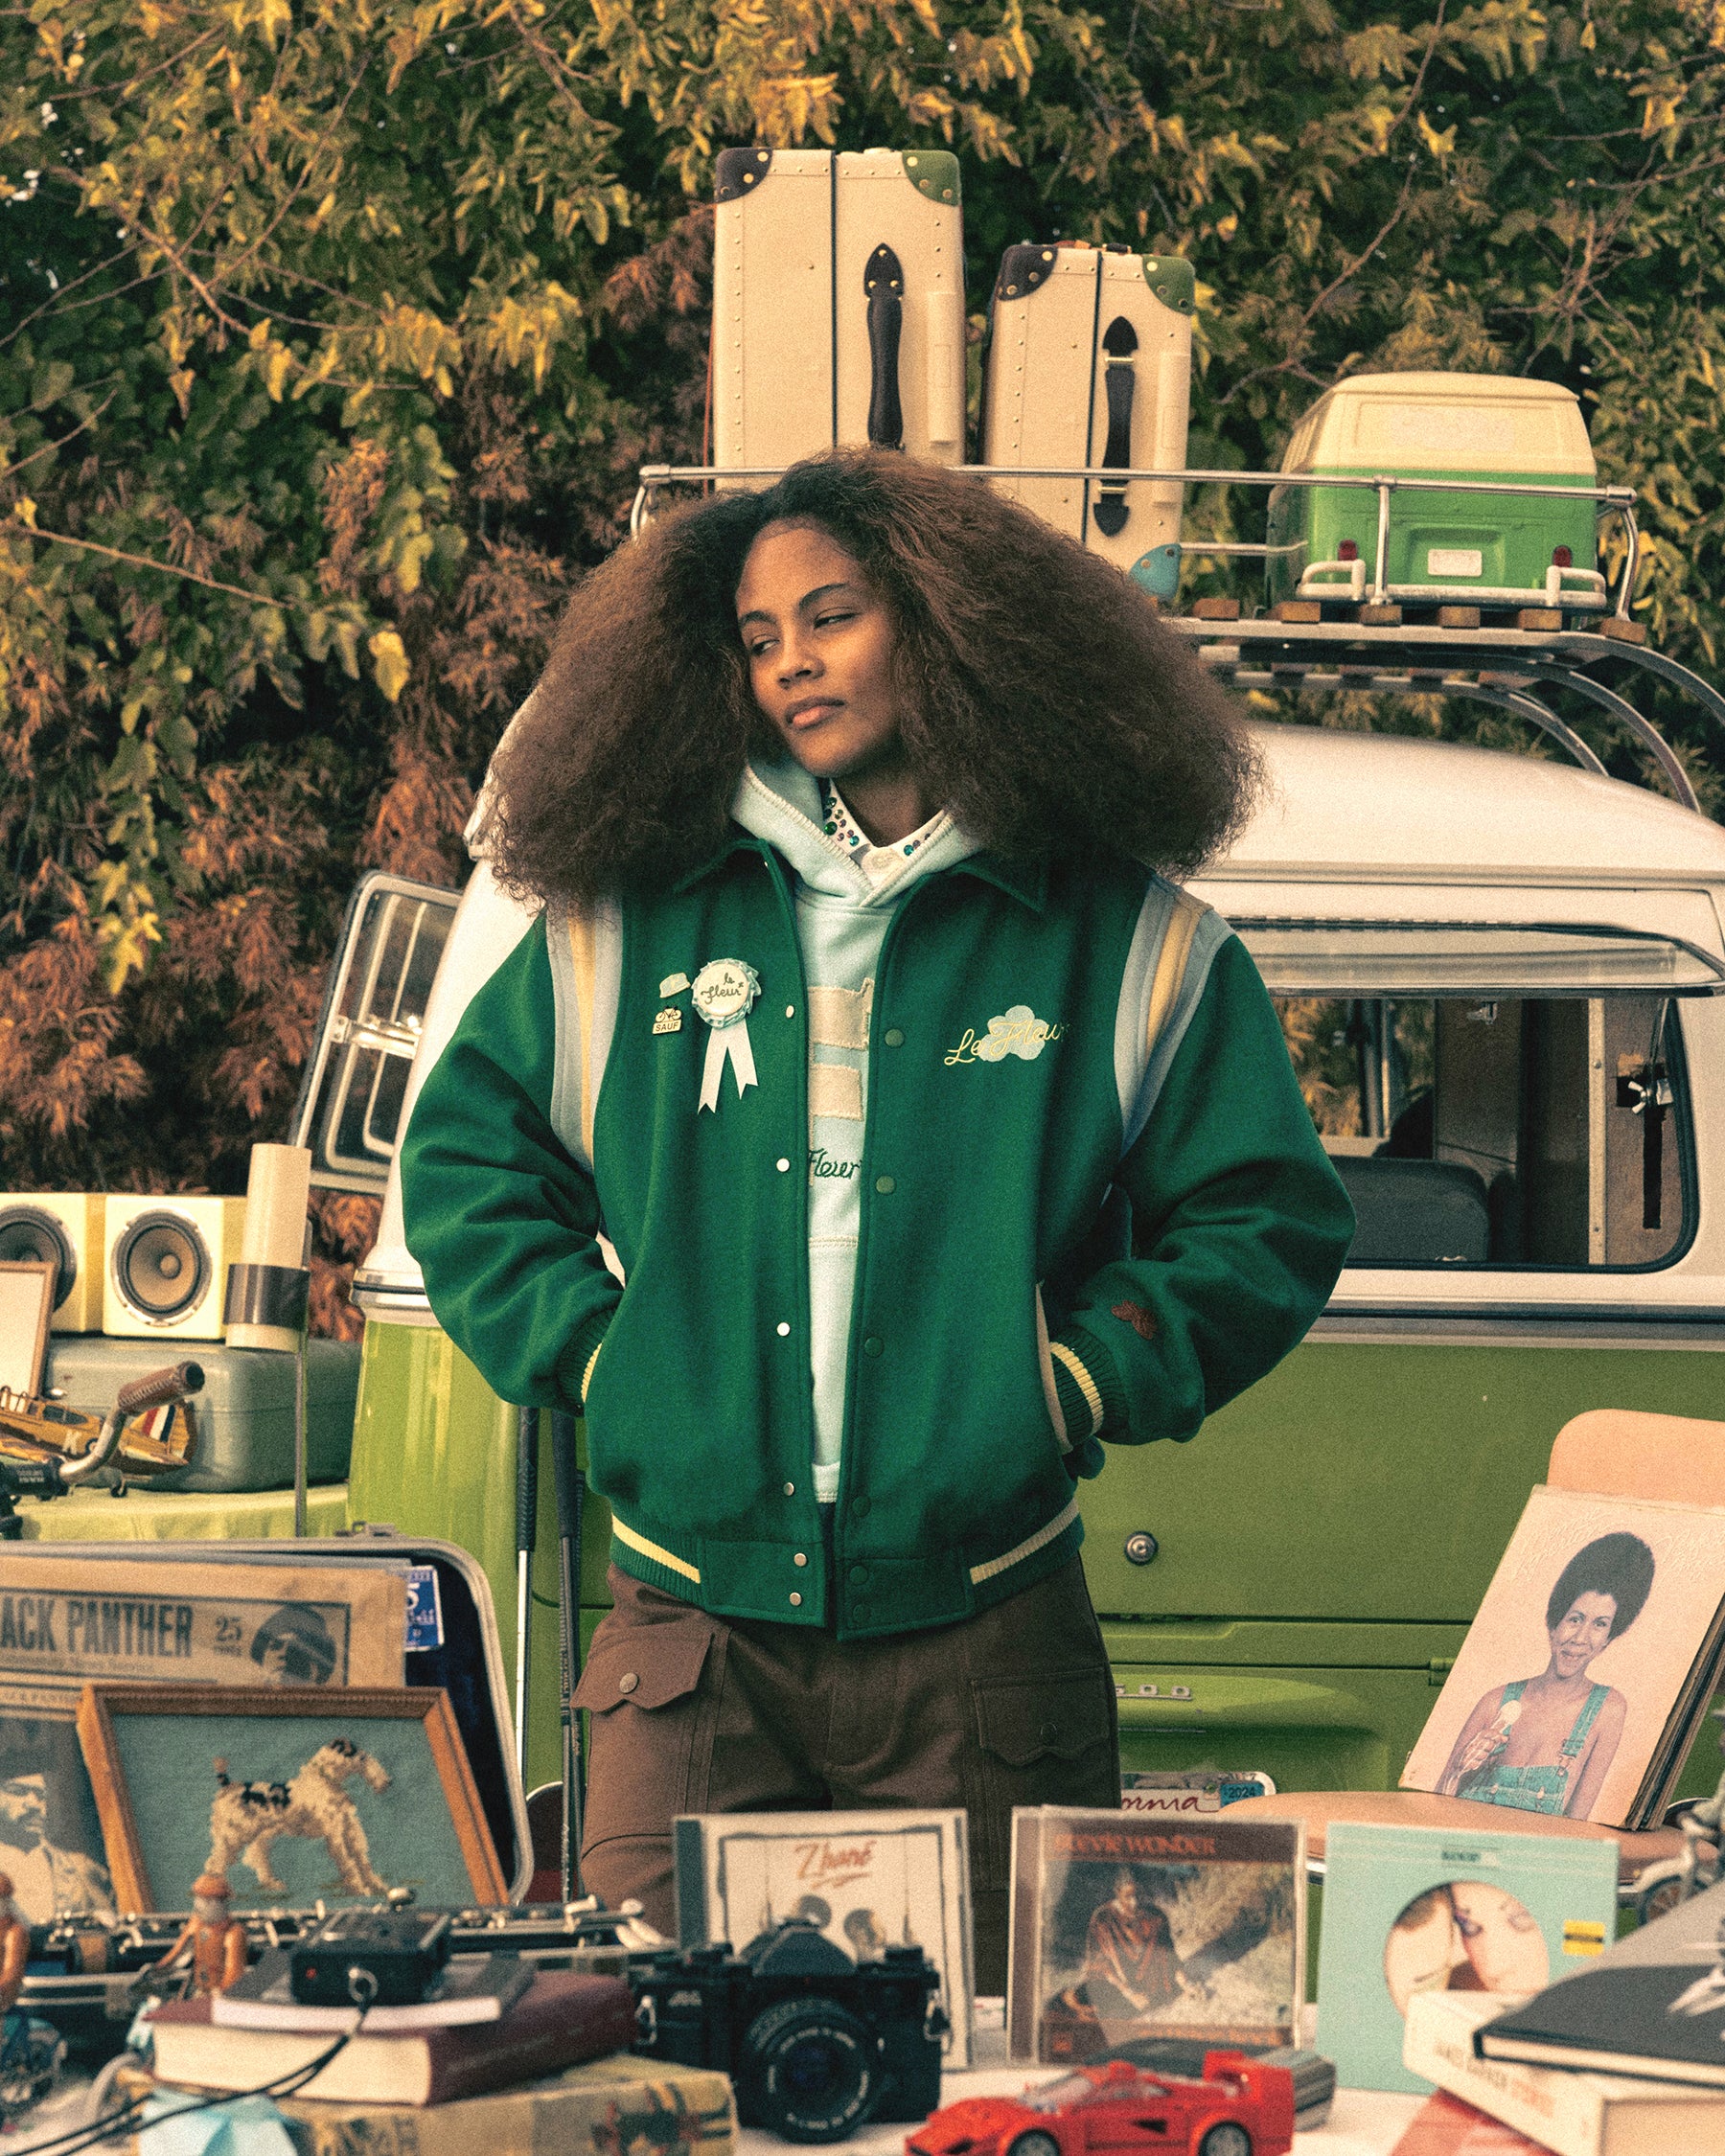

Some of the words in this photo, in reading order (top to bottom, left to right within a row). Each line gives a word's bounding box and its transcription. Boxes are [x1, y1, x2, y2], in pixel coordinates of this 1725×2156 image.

[655, 1021, 679, 1033] SAUF
[943, 1028, 986, 1066] Le
[67, 1599, 192, 1658] PANTHER
[215, 1616, 243, 1641] 25
[1230, 1786, 1256, 1799] 2024
[1125, 1834, 1215, 1855] WONDER
